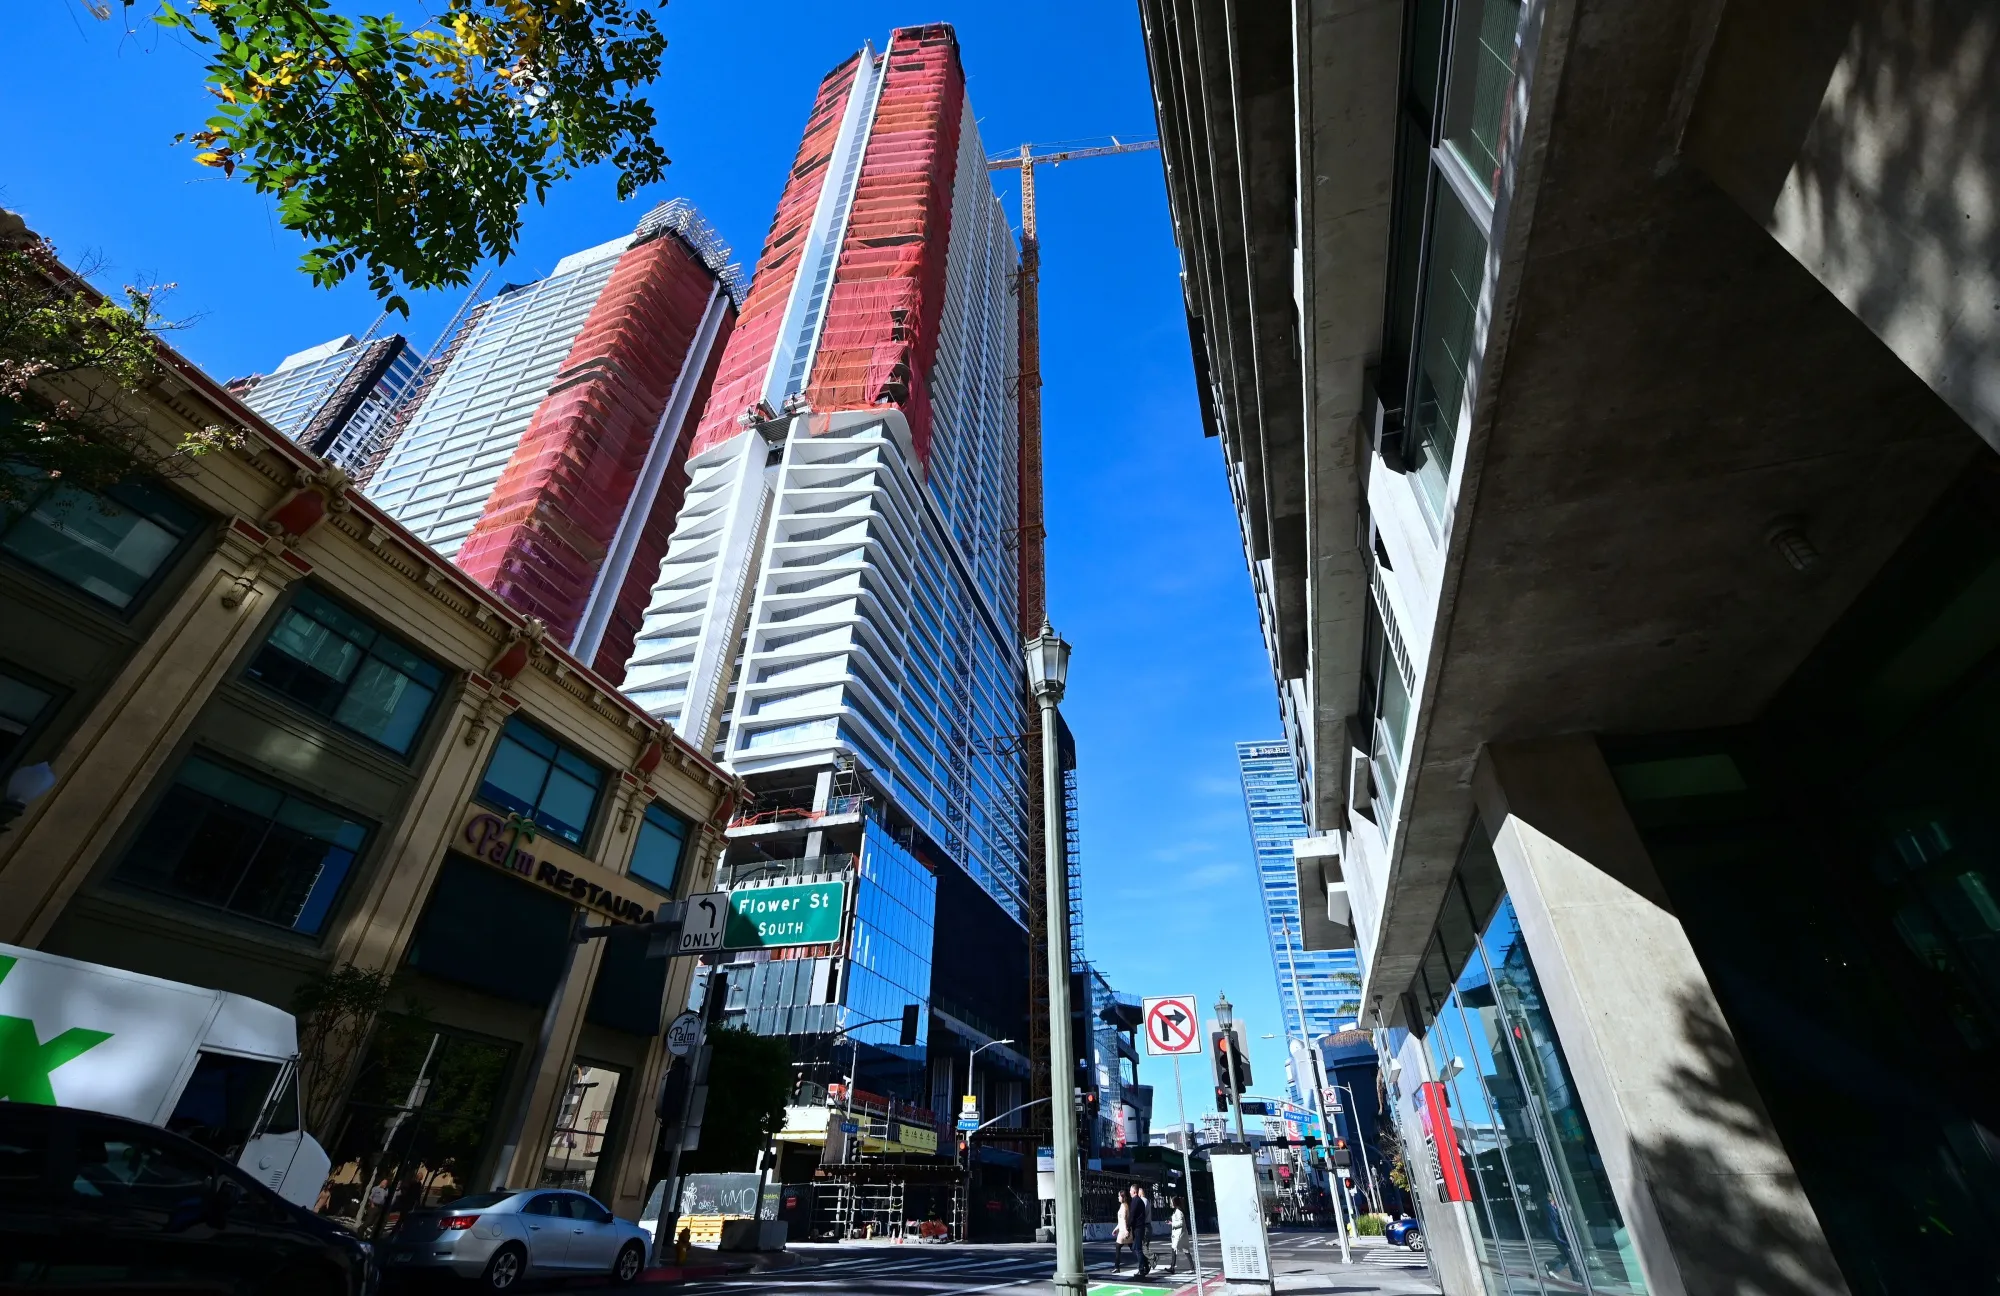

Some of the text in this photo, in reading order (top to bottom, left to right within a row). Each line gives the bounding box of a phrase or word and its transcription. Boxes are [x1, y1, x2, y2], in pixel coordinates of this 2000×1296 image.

[465, 812, 655, 924] Palm RESTAURA
[738, 893, 829, 915] Flower St
[758, 922, 804, 937] SOUTH
[683, 931, 720, 948] ONLY
[669, 1018, 695, 1043] Palm
[1266, 1102, 1273, 1110] St
[1285, 1113, 1303, 1122] Flower
